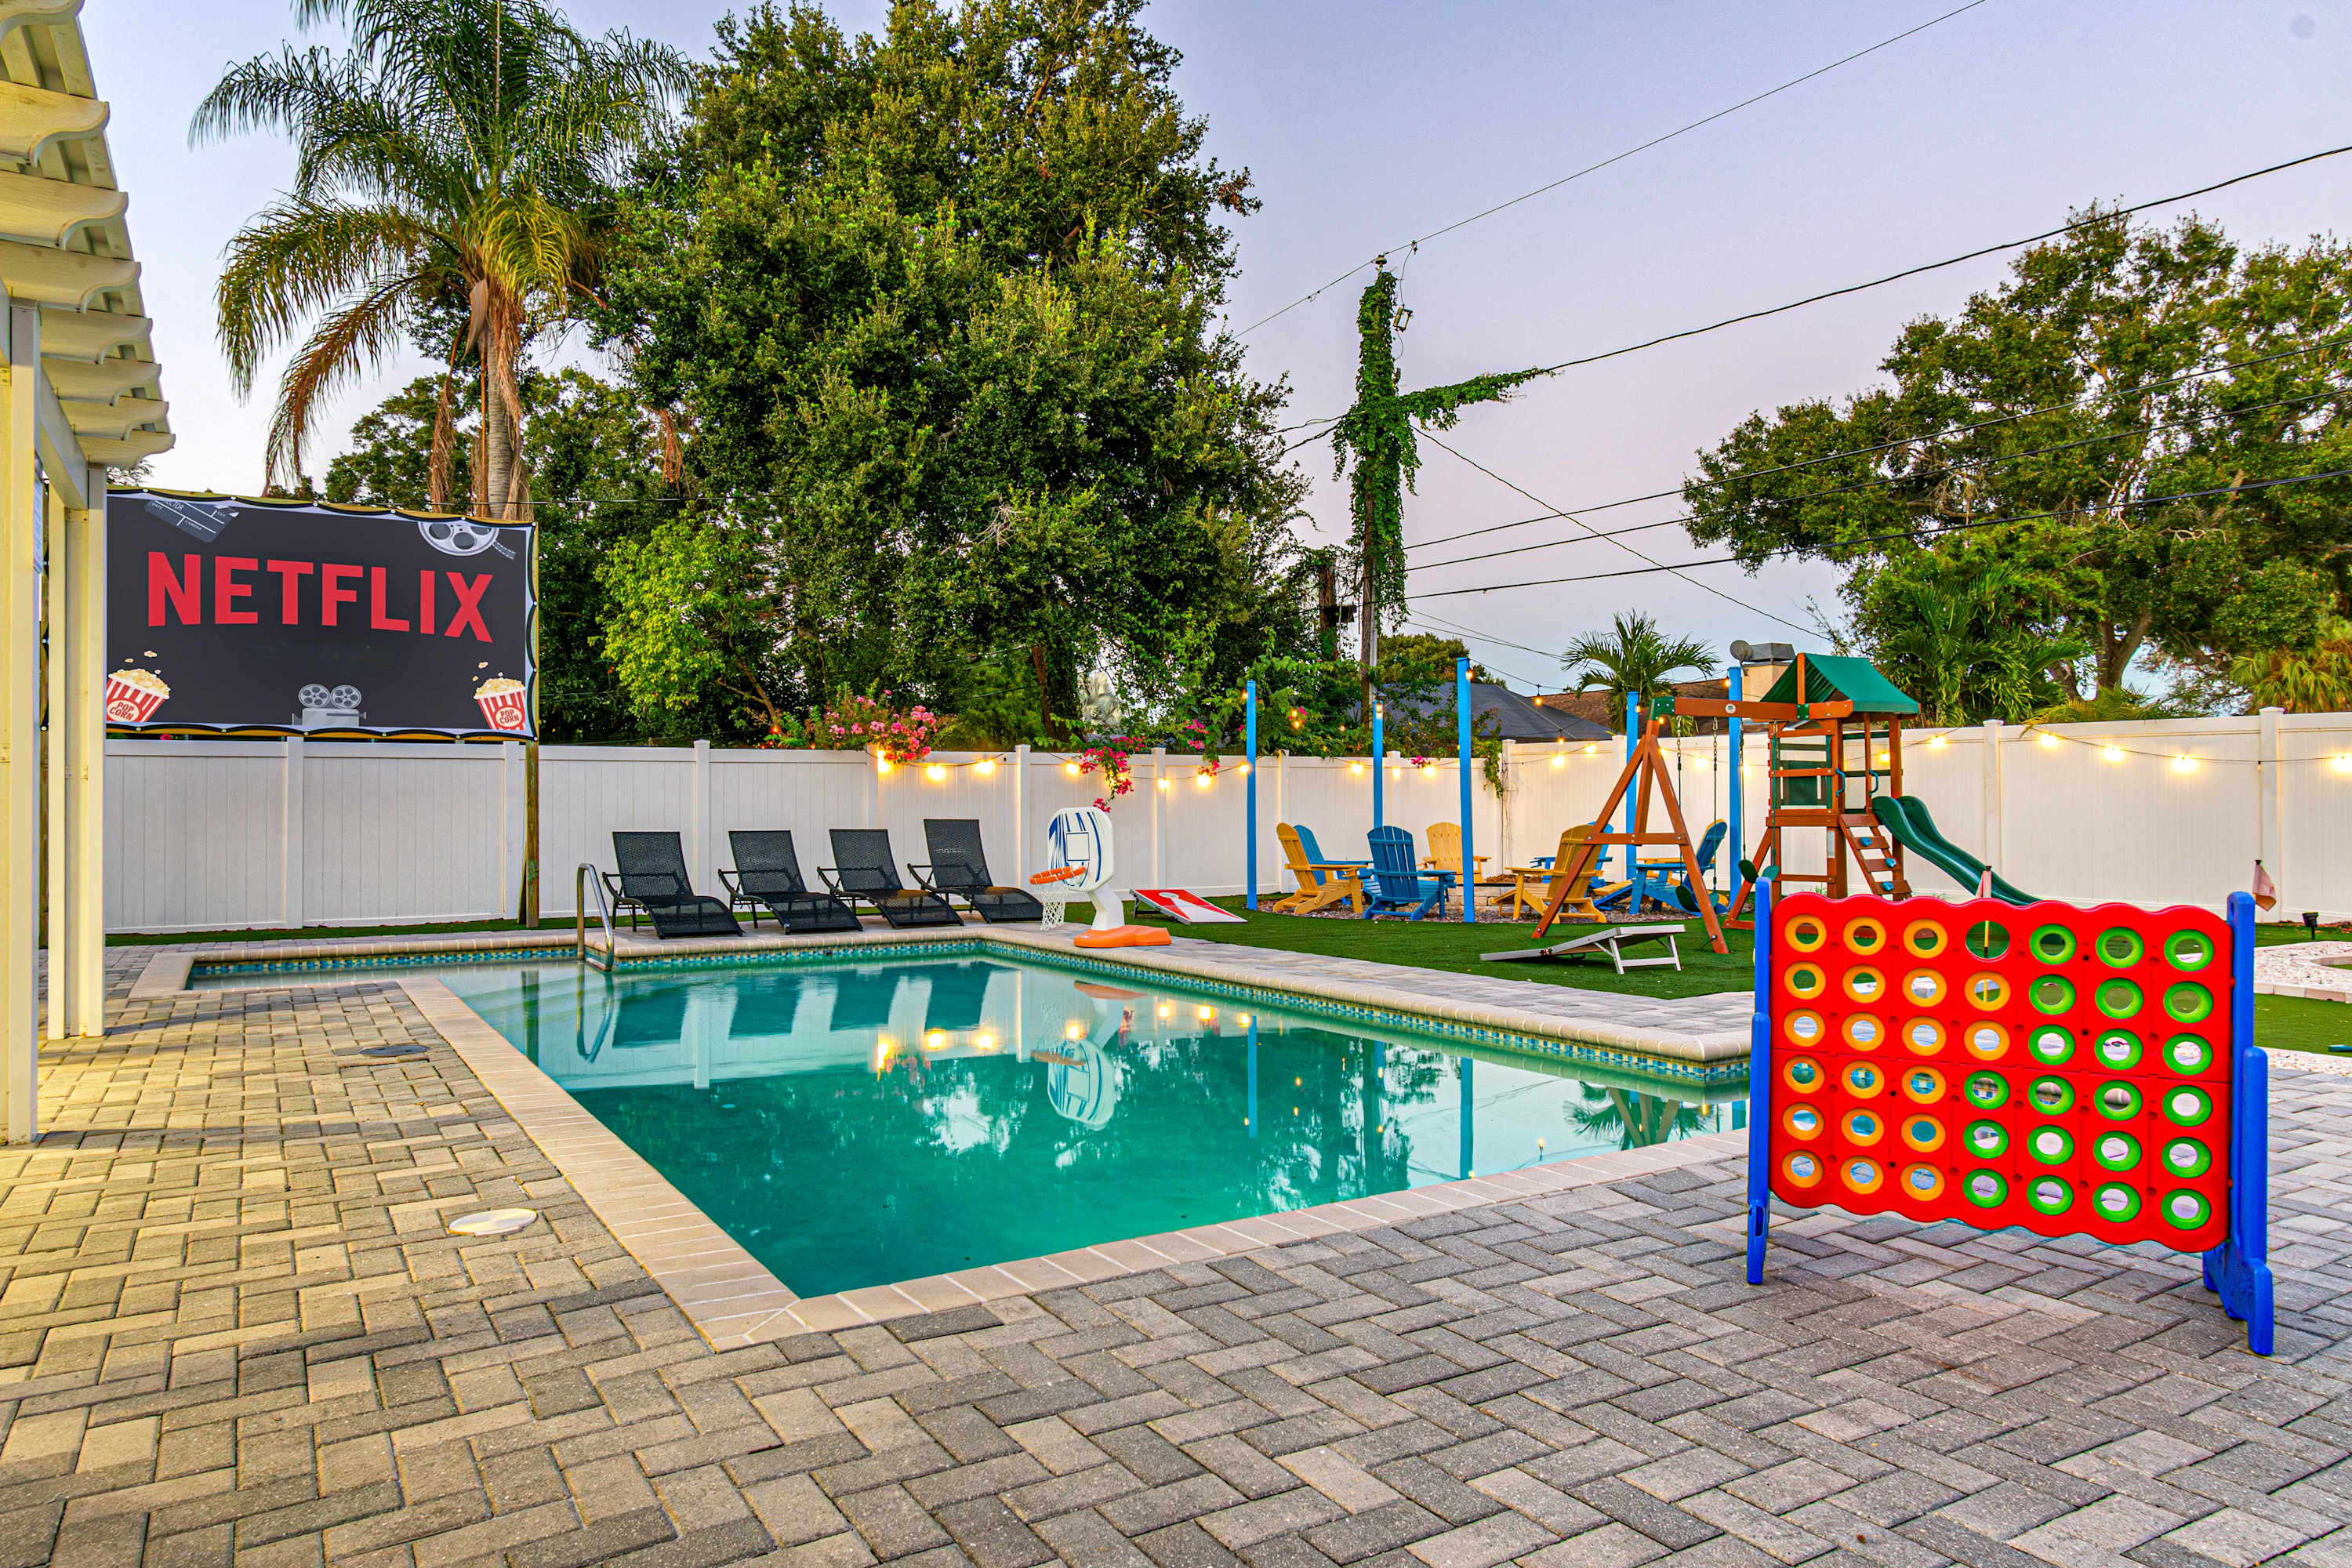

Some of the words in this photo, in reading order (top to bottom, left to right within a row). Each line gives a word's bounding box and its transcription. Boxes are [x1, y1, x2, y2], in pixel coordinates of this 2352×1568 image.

[184, 520, 201, 531] CAMERA
[148, 551, 493, 643] NETFLIX
[109, 706, 133, 720] CORN
[117, 702, 134, 713] POP
[499, 714, 519, 724] CORN
